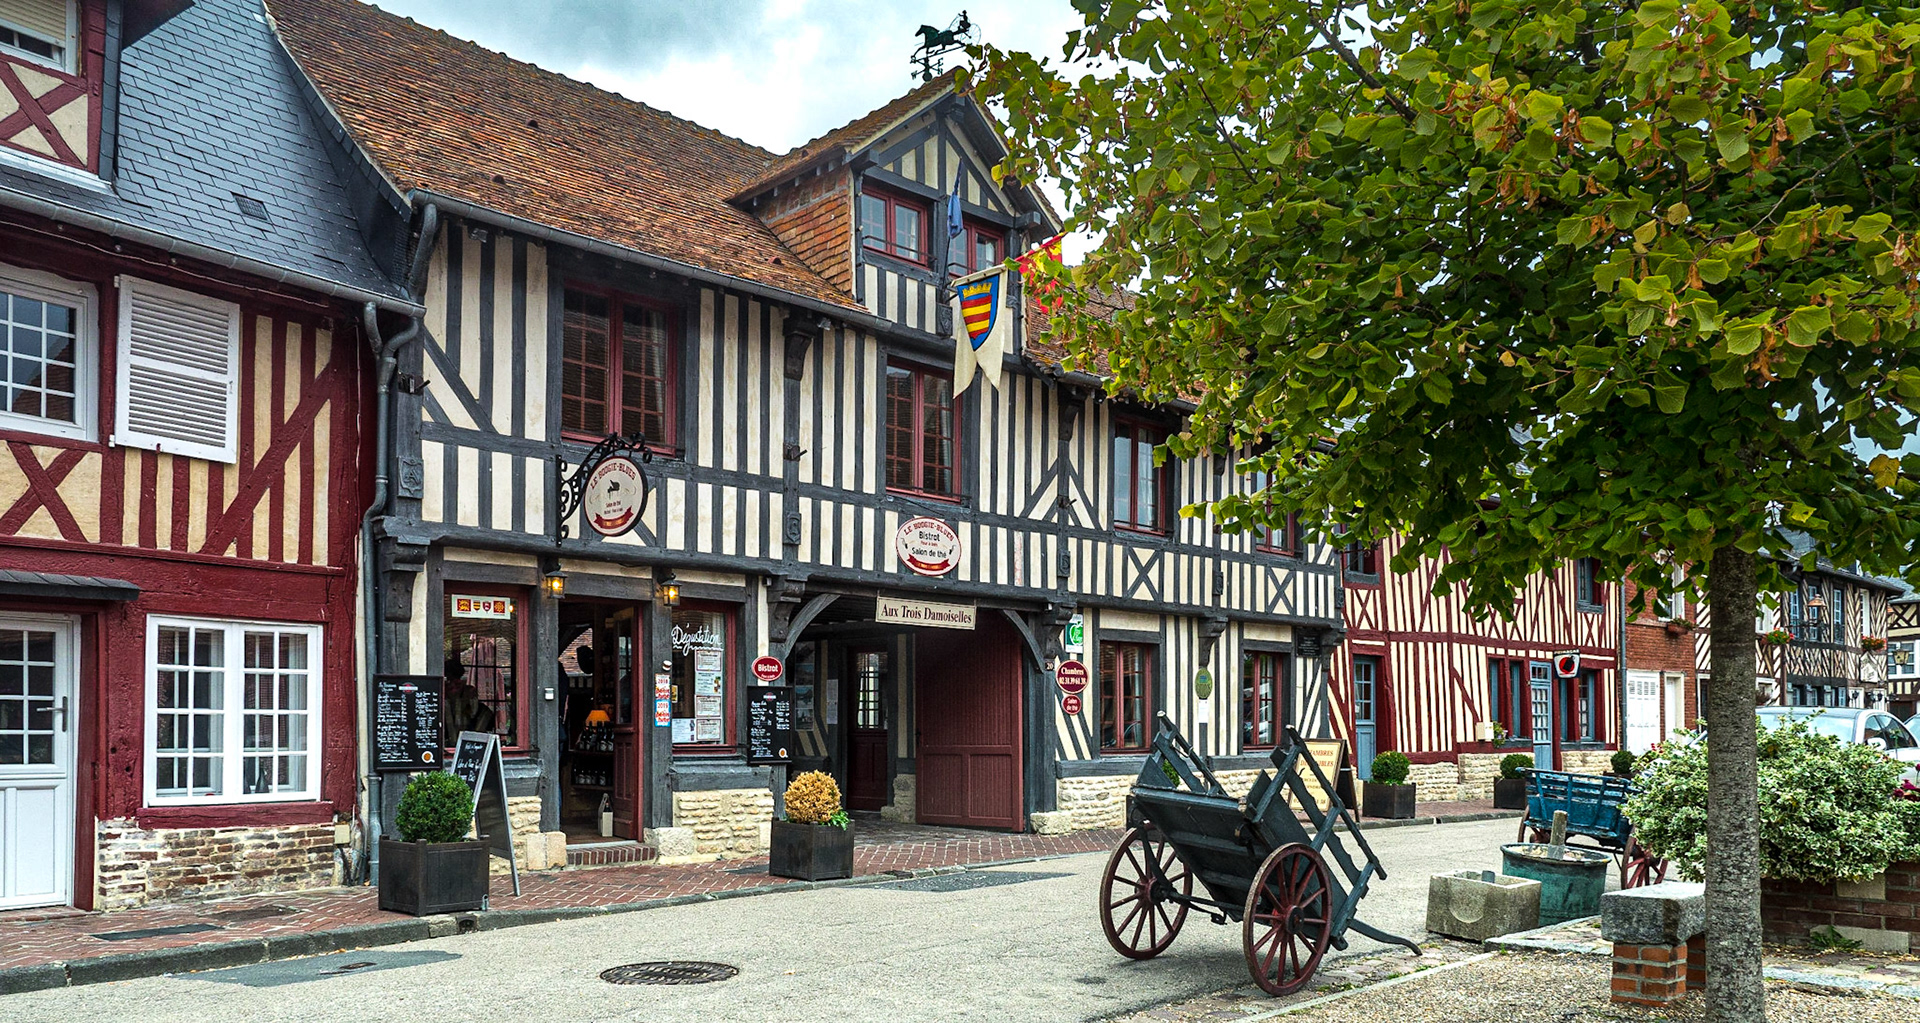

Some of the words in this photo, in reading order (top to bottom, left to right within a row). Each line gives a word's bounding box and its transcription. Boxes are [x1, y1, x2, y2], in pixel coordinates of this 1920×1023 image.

[590, 476, 598, 489] LE
[904, 525, 913, 535] LE
[919, 531, 940, 541] Bistrot
[912, 547, 927, 556] Salon
[929, 549, 936, 557] de
[881, 603, 899, 617] Aux
[901, 605, 922, 619] Trois
[924, 607, 971, 623] Damoiselles
[671, 623, 722, 656] Dégustation
[758, 664, 778, 672] Bistrot
[1061, 667, 1084, 675] Chambres
